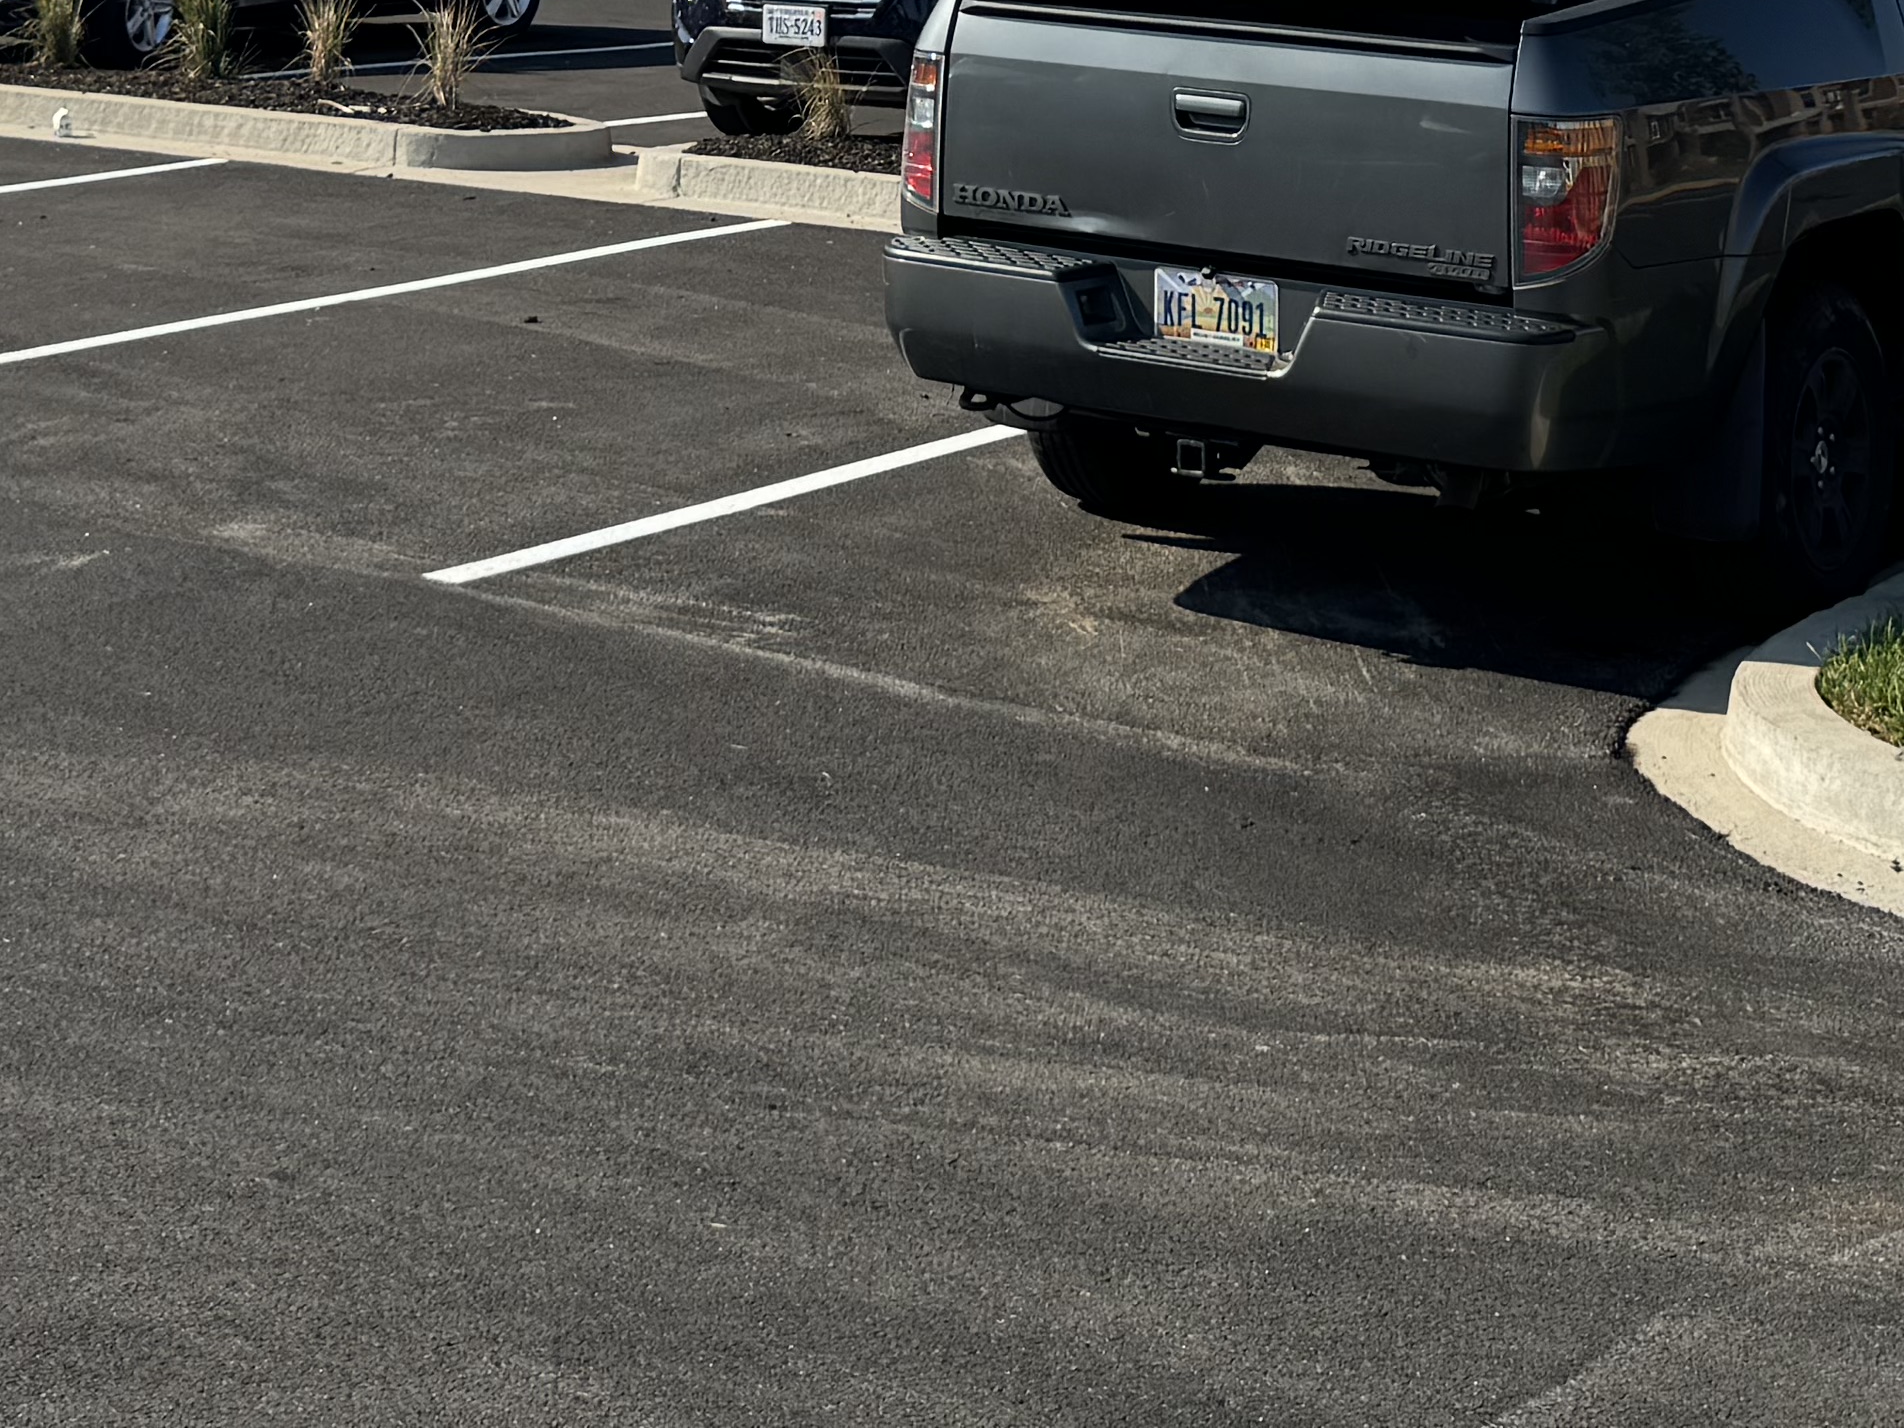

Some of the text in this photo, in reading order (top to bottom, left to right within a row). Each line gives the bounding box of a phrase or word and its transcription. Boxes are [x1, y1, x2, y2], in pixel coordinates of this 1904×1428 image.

[952, 183, 1072, 218] HONDA
[1347, 236, 1496, 267] RIDGELINE
[1163, 290, 1267, 339] KFL 7091
